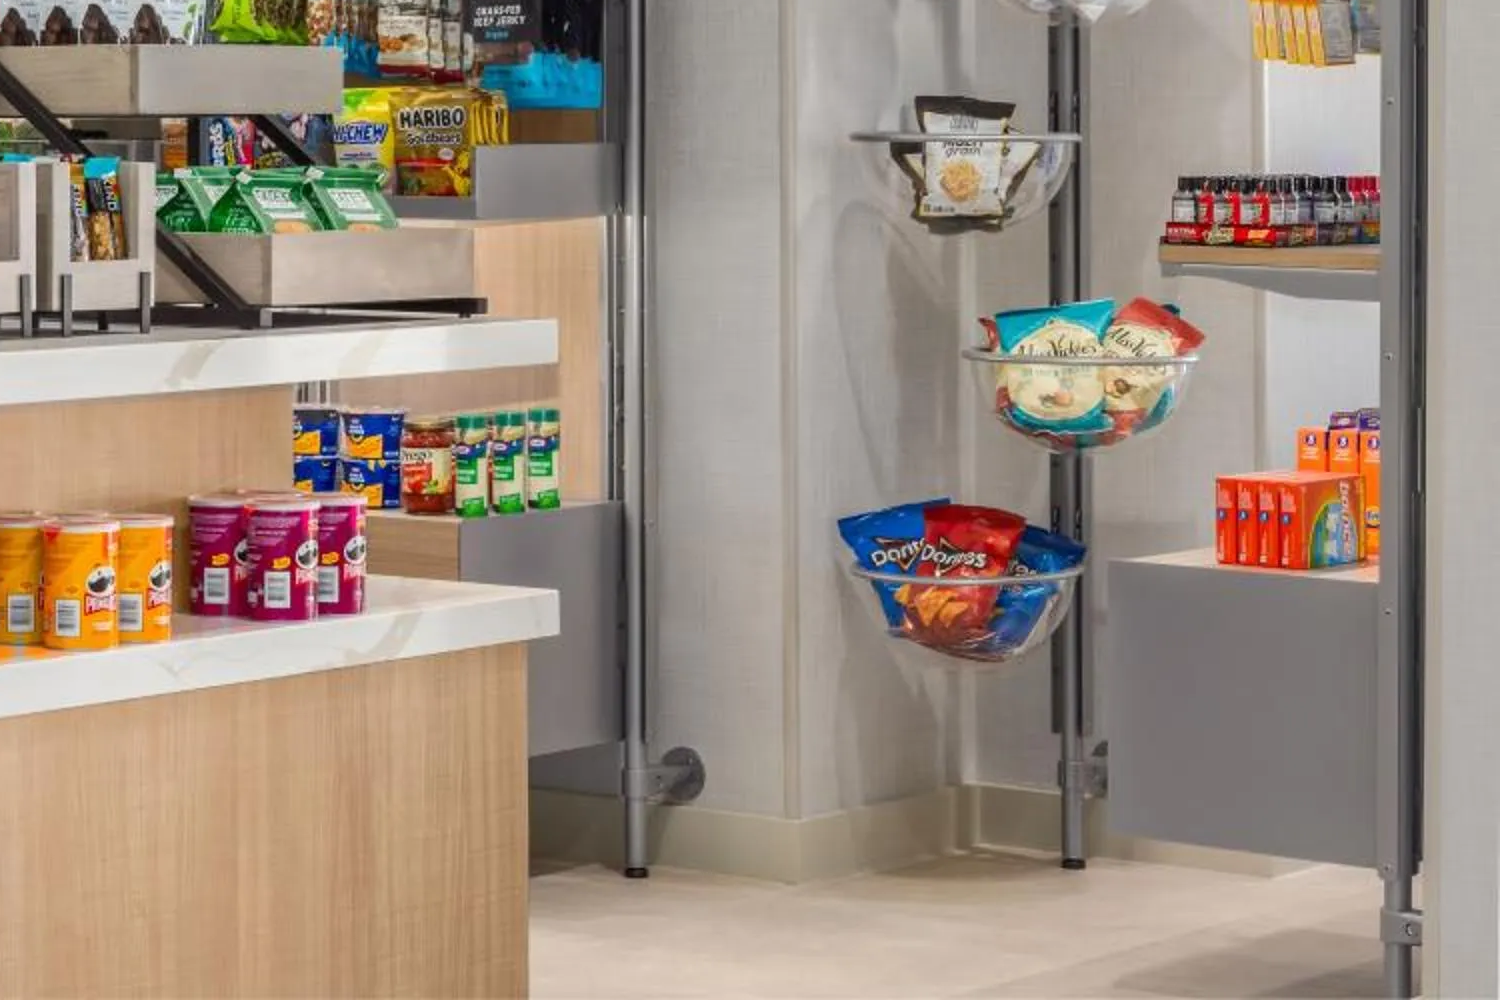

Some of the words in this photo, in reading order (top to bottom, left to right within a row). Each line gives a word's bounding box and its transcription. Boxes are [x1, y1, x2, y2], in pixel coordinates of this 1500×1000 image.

[473, 17, 494, 27] BEEF
[496, 15, 526, 26] JERKY
[399, 107, 465, 129] HARIBO
[406, 132, 461, 146] Goldbears
[104, 180, 117, 211] KIND
[921, 543, 988, 569] Doritos
